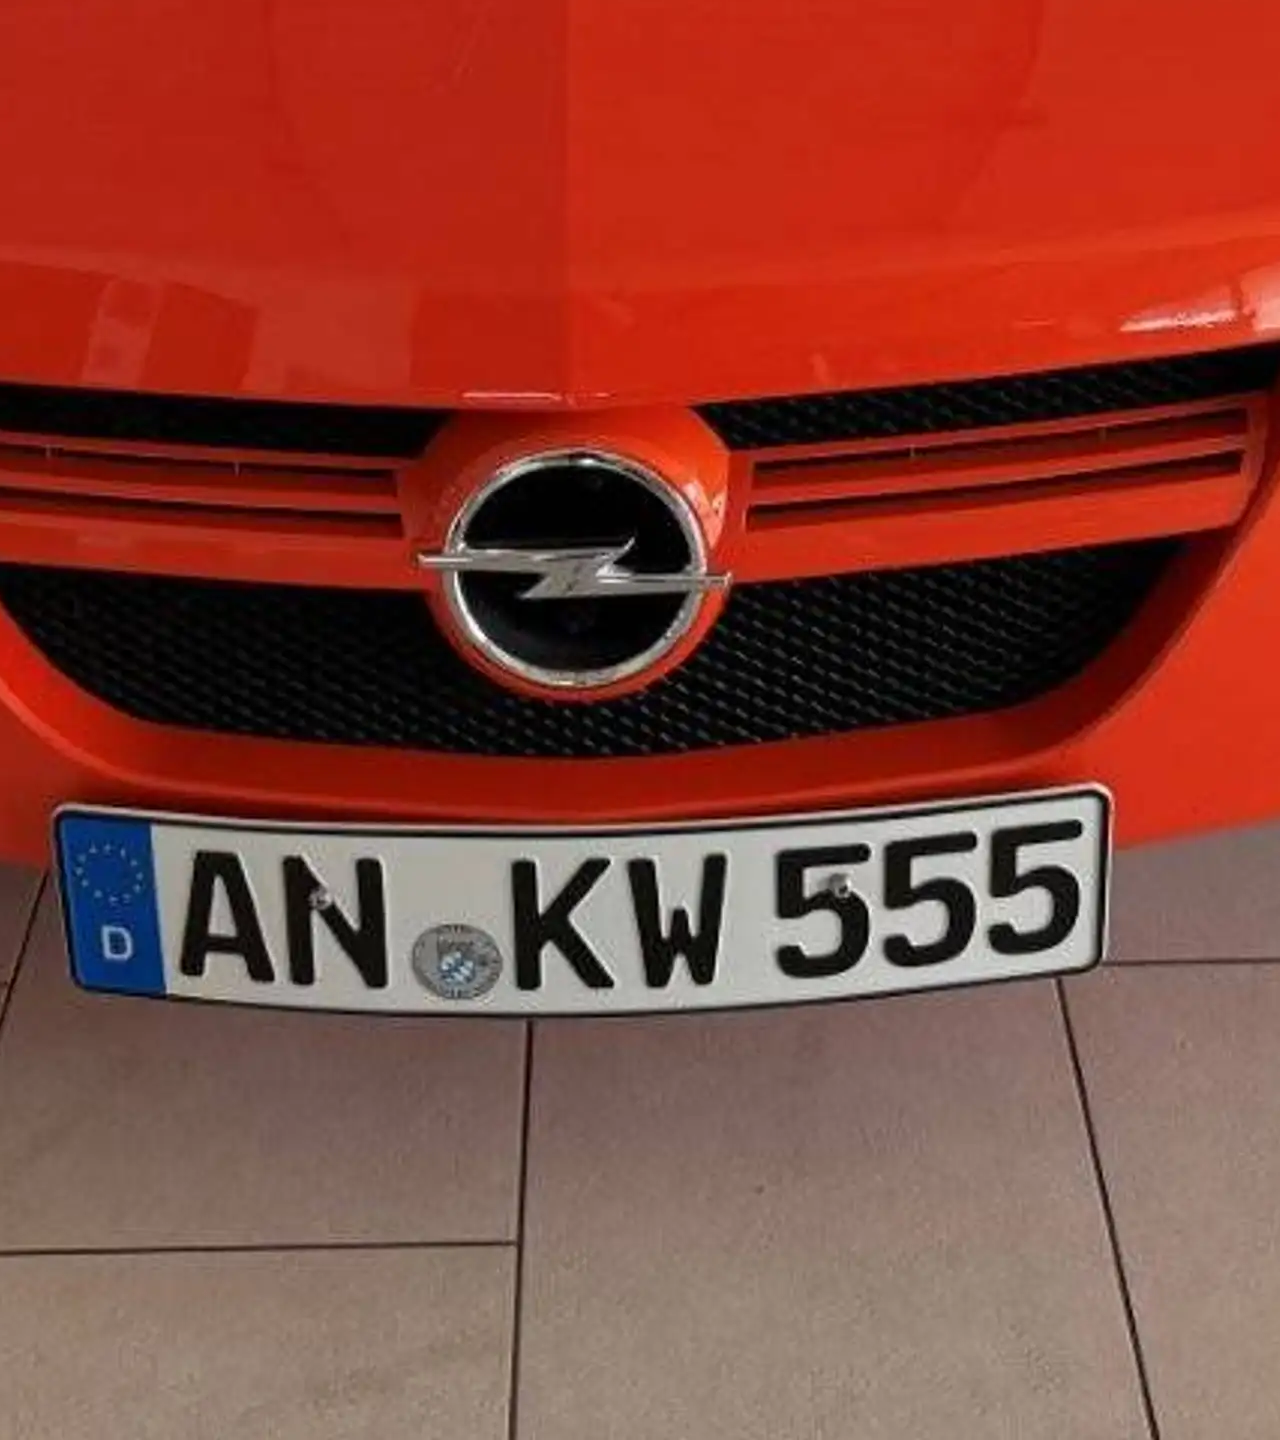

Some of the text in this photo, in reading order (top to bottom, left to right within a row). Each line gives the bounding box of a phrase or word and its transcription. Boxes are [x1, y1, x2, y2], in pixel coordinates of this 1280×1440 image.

[100, 924, 134, 962] D
[179, 849, 389, 990] AN
[511, 853, 728, 991] KW
[774, 819, 1084, 980] 555
